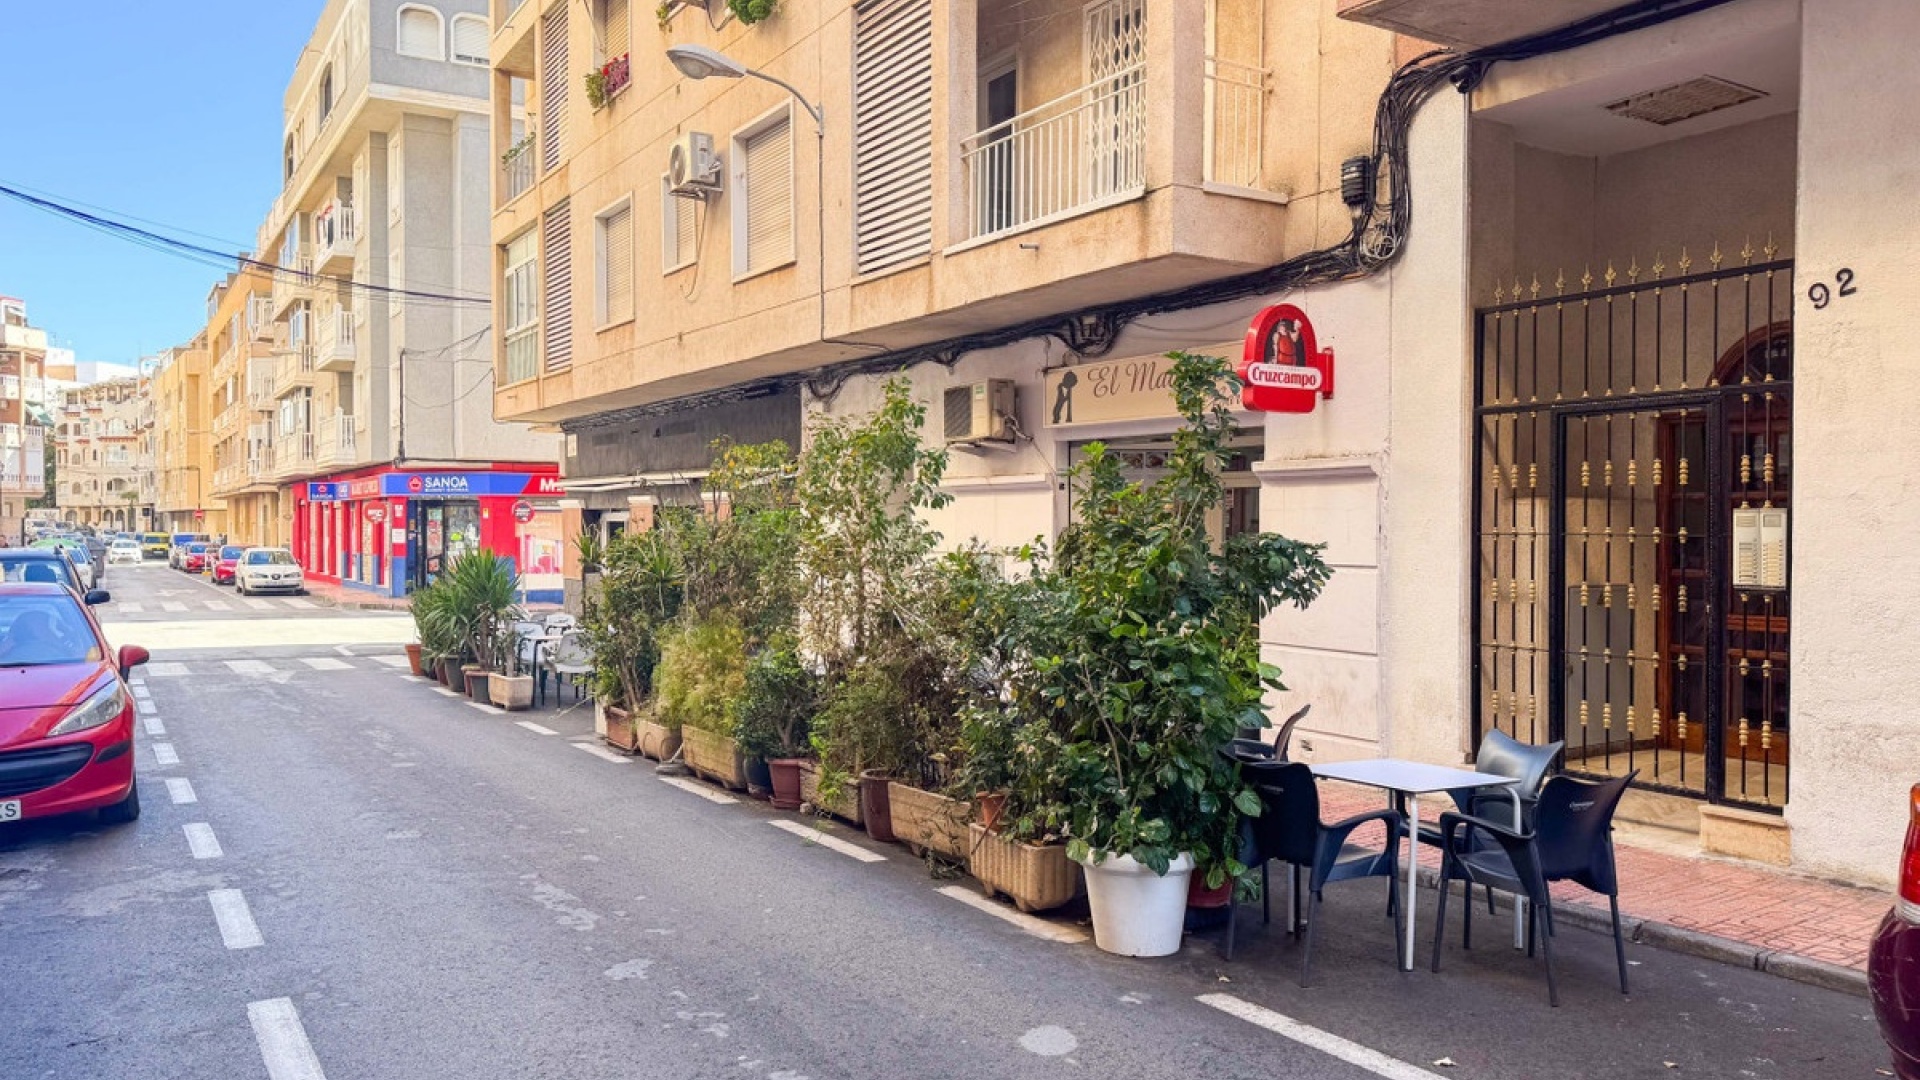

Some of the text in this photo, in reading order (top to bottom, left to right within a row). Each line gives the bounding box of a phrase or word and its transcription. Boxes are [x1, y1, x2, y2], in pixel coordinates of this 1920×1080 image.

[1807, 267, 1857, 310] 92
[1088, 366, 1121, 398] El
[1252, 366, 1316, 387] Cruzcampo
[425, 475, 468, 488] SANOA
